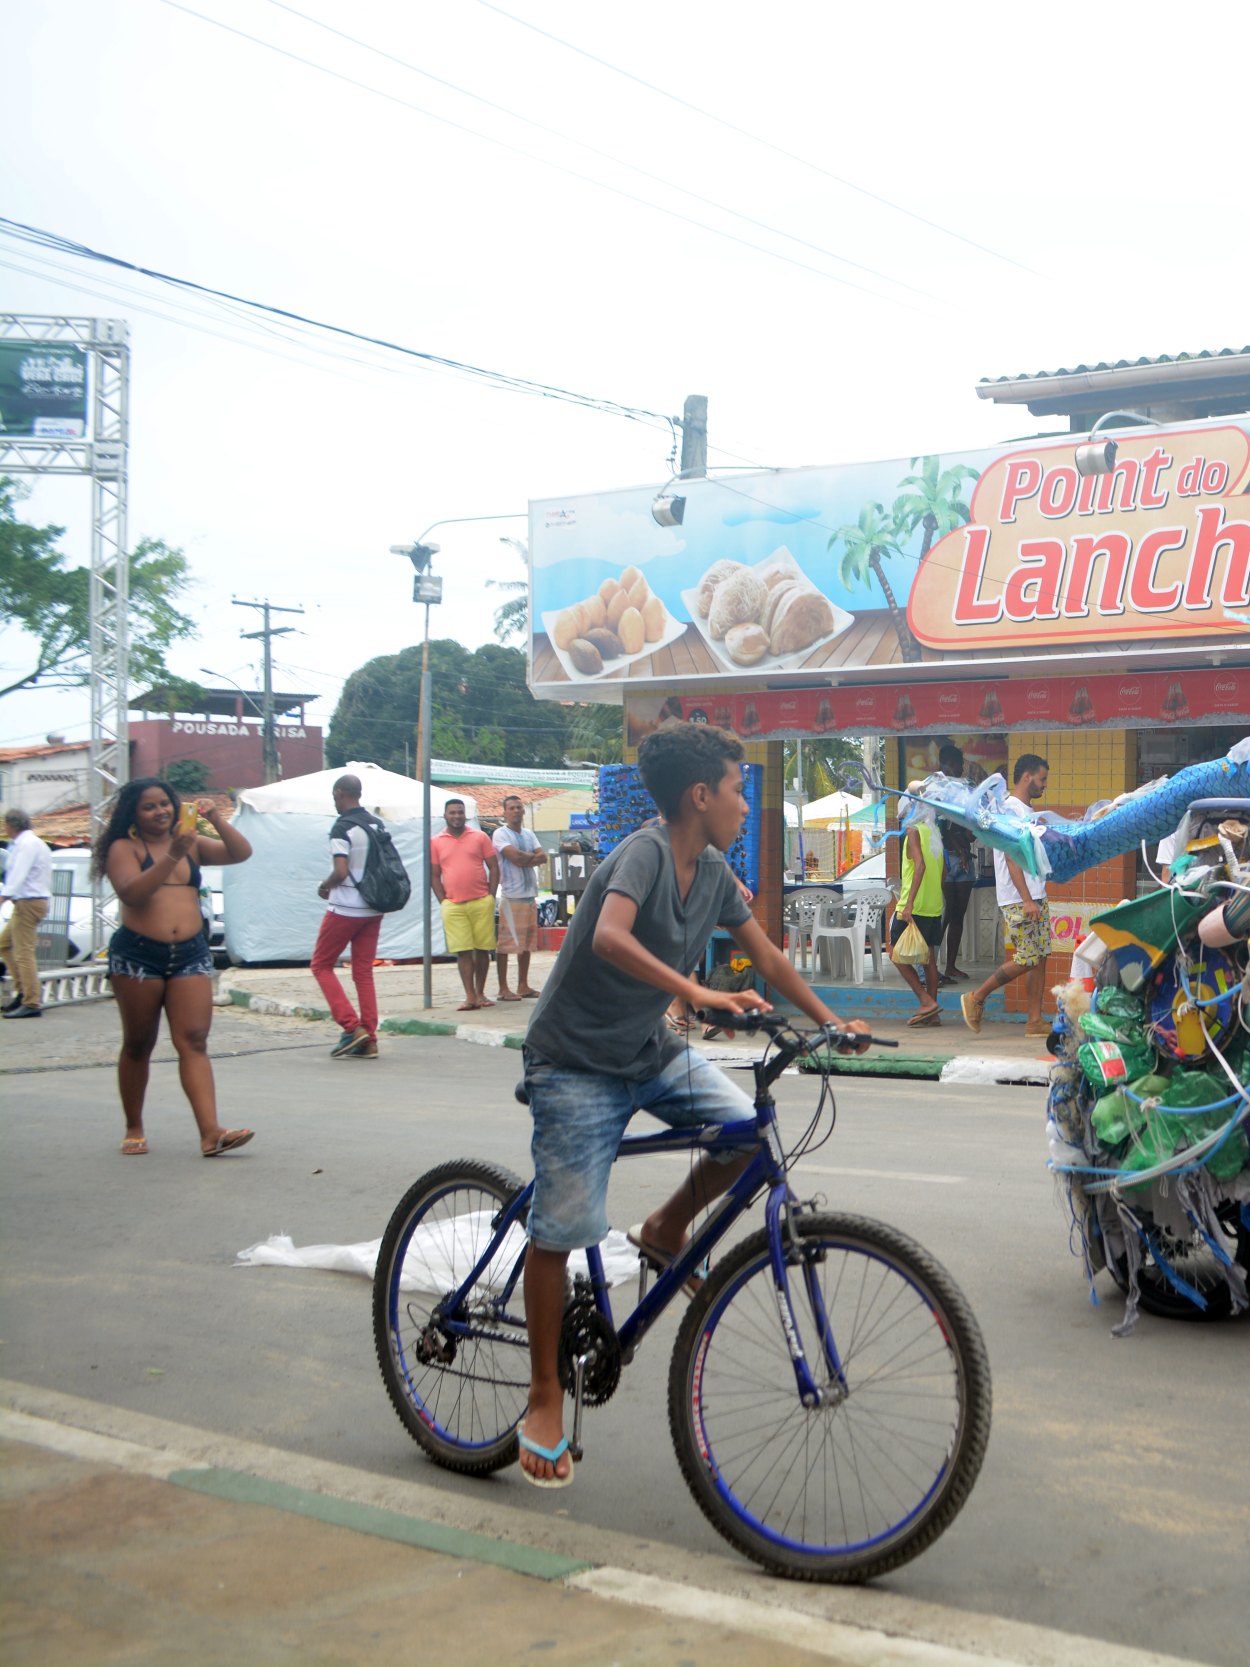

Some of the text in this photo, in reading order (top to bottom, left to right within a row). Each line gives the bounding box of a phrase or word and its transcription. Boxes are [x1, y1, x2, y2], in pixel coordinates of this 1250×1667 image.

[999, 446, 1230, 523] Point do
[172, 721, 250, 736] POUSADA
